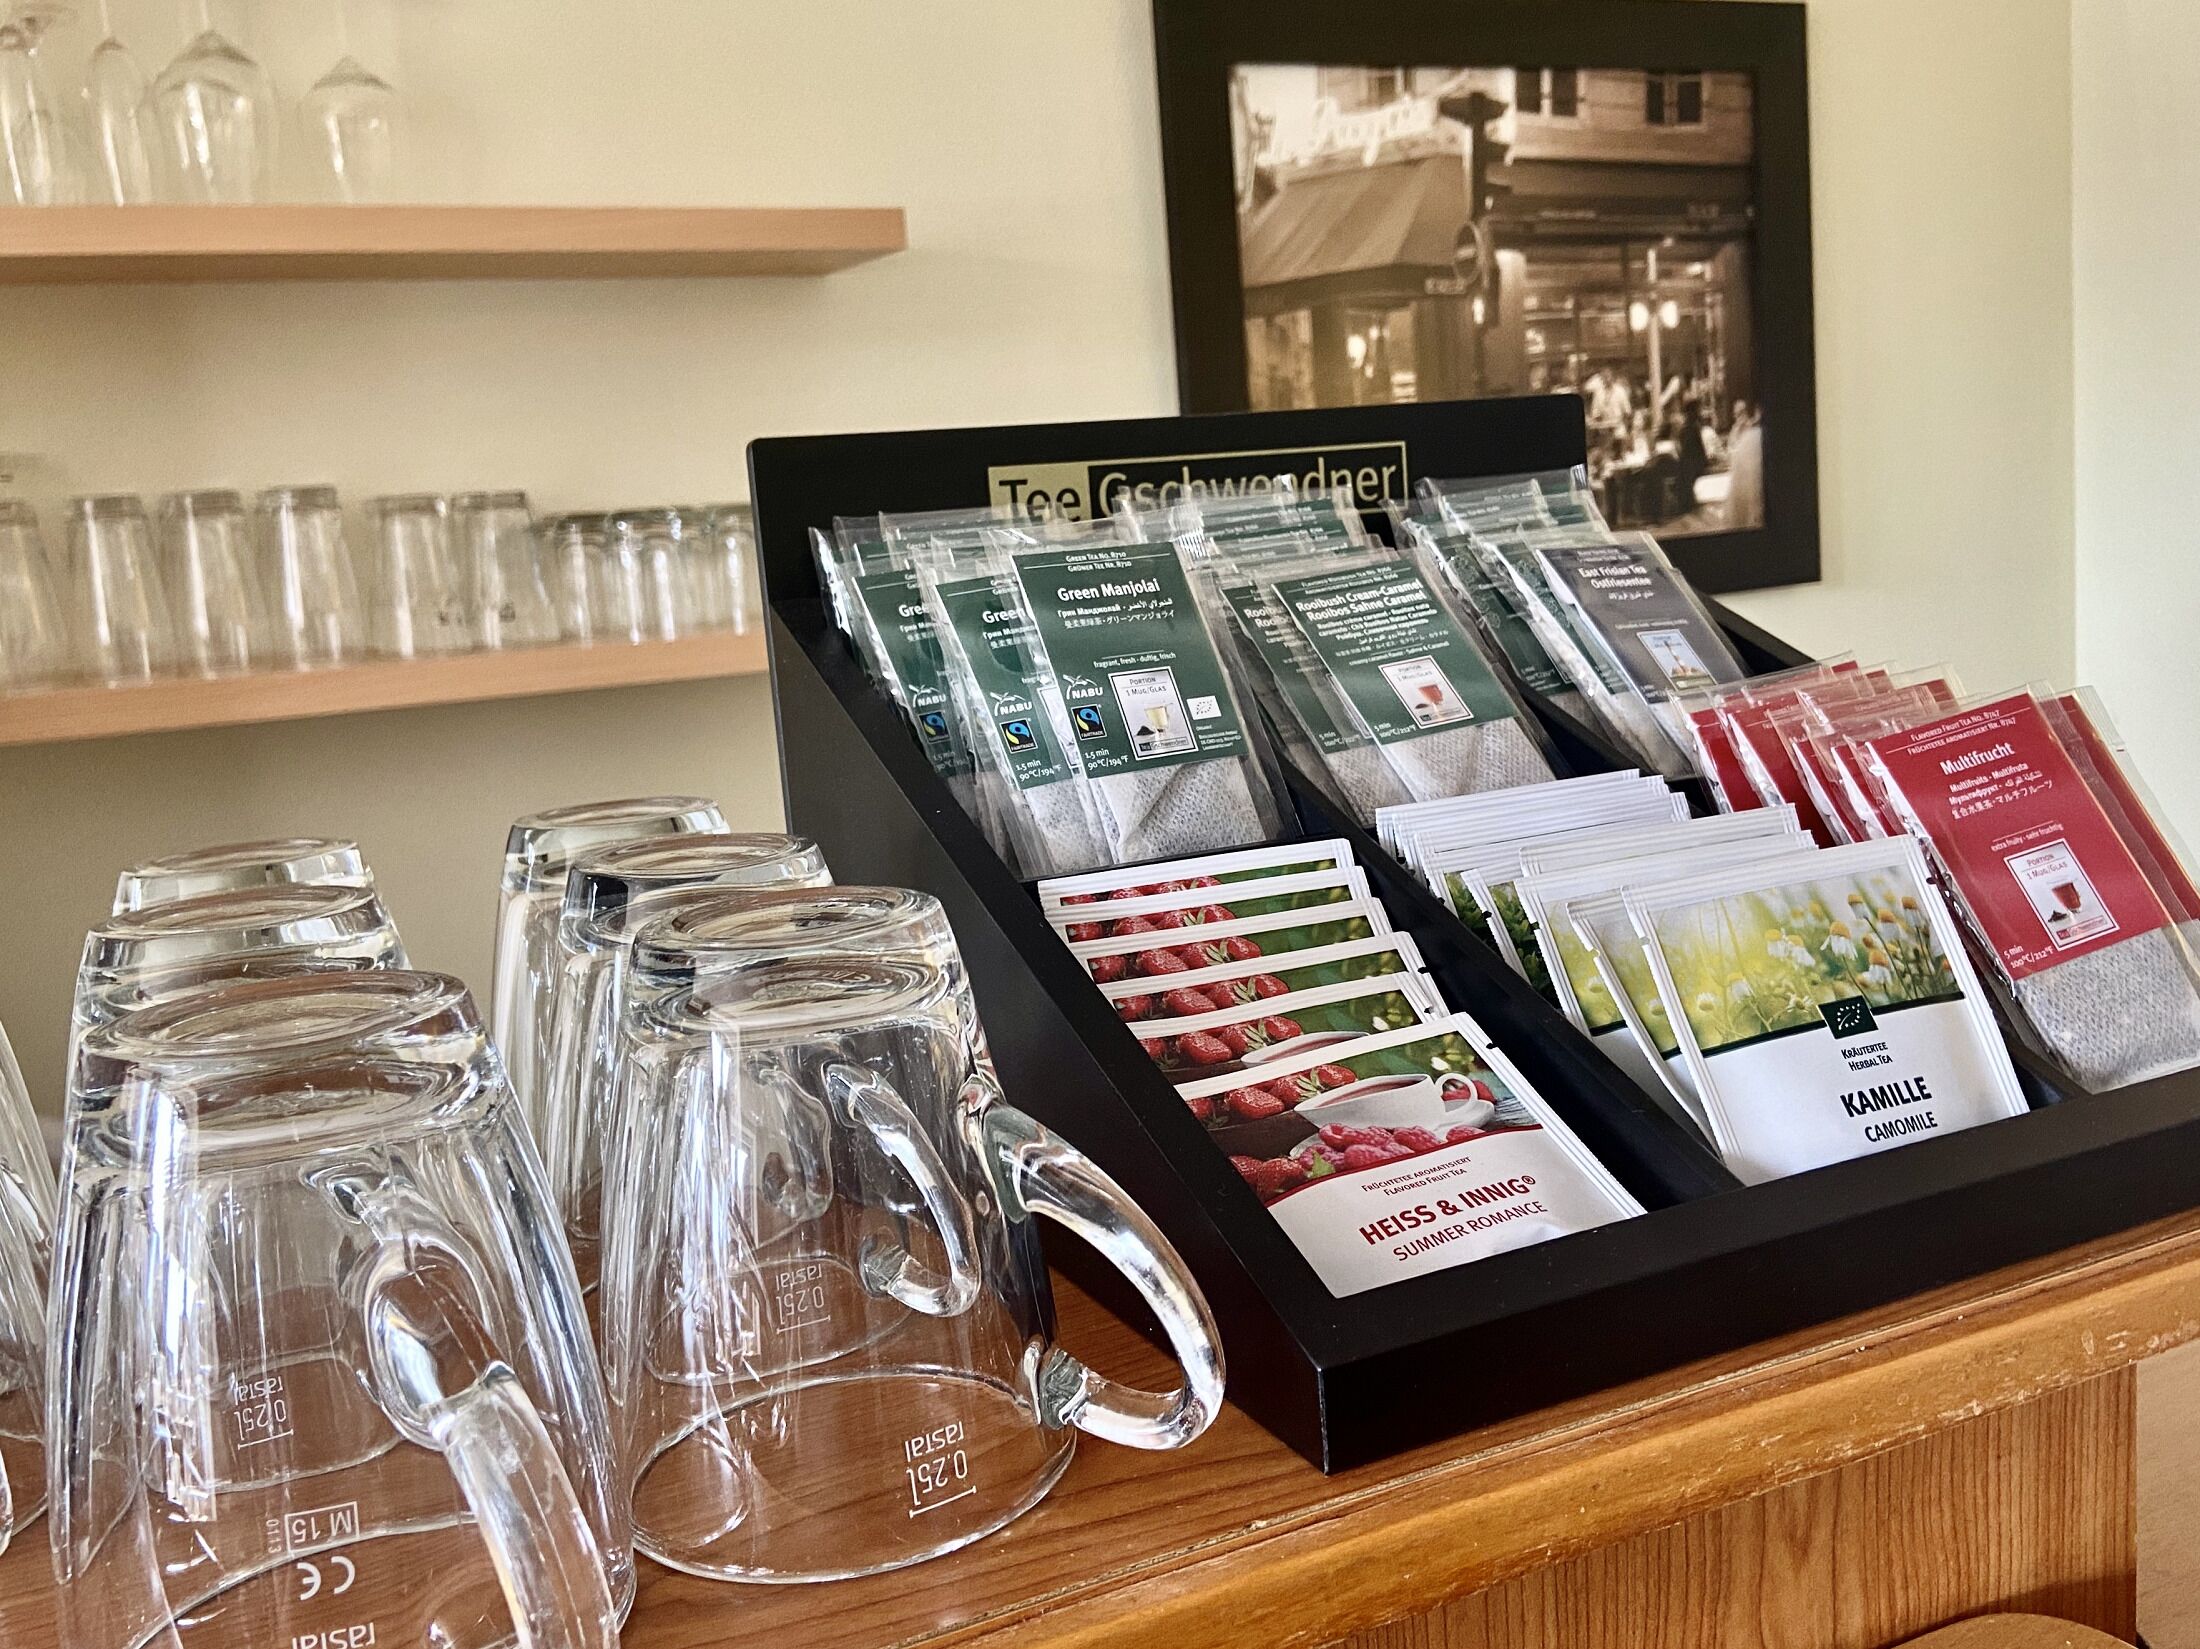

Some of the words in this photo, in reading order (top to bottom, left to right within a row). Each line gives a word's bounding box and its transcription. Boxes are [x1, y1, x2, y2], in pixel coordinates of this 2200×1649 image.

[998, 480, 1080, 521] Tee
[1578, 568, 1601, 578] East
[1628, 564, 1648, 574] Tea
[1058, 587, 1100, 601] Green
[1100, 578, 1160, 598] Manjolai
[1296, 594, 1347, 612] Rooibush
[1346, 578, 1424, 604] Cream-Caramel
[898, 604, 930, 618] Gre
[982, 608, 1026, 624] Green
[1306, 605, 1351, 622] Rooibos
[1350, 598, 1384, 612] Sahne
[1384, 590, 1427, 606] Caramel
[1120, 656, 1136, 664] fresh
[1129, 677, 1156, 686] PORTION
[918, 694, 946, 706] NABU
[1071, 687, 1104, 700] NABU
[1000, 702, 1033, 716] NABU
[1960, 718, 1972, 726] TEA
[1027, 760, 1042, 768] min
[1084, 751, 1096, 760] 1.5
[1096, 748, 1110, 758] min
[1940, 742, 2016, 776] Multifrucht
[1949, 774, 1989, 793] Multifruits
[1991, 762, 2029, 780] Multifruta
[2004, 951, 2010, 960] 5
[2009, 944, 2024, 956] min
[1840, 1042, 1888, 1060] KRÄUTERTEE
[1848, 1057, 1880, 1072] HERBAL
[1878, 1054, 1893, 1066] TEA
[1840, 1076, 1932, 1118] KAMILLE
[1864, 1111, 1938, 1143] CAMOMILE
[1361, 1174, 1414, 1192] FRÜCHTETEE
[1414, 1156, 1472, 1178] AROMATISIERT
[1384, 1180, 1427, 1196] FLAVORED
[1426, 1172, 1452, 1187] FRUIT
[1450, 1168, 1466, 1181] TEA
[1358, 1204, 1437, 1246] HEISS
[1436, 1199, 1464, 1217] &
[1458, 1175, 1537, 1209] INNIG®
[1393, 1224, 1472, 1262] SUMMER
[1470, 1201, 1548, 1233] ROMANCE
[234, 1400, 286, 1440] 025l
[905, 1421, 964, 1462] rastal
[906, 1450, 968, 1506] 0.25l
[292, 1520, 321, 1543] 15
[330, 1510, 352, 1536] M
